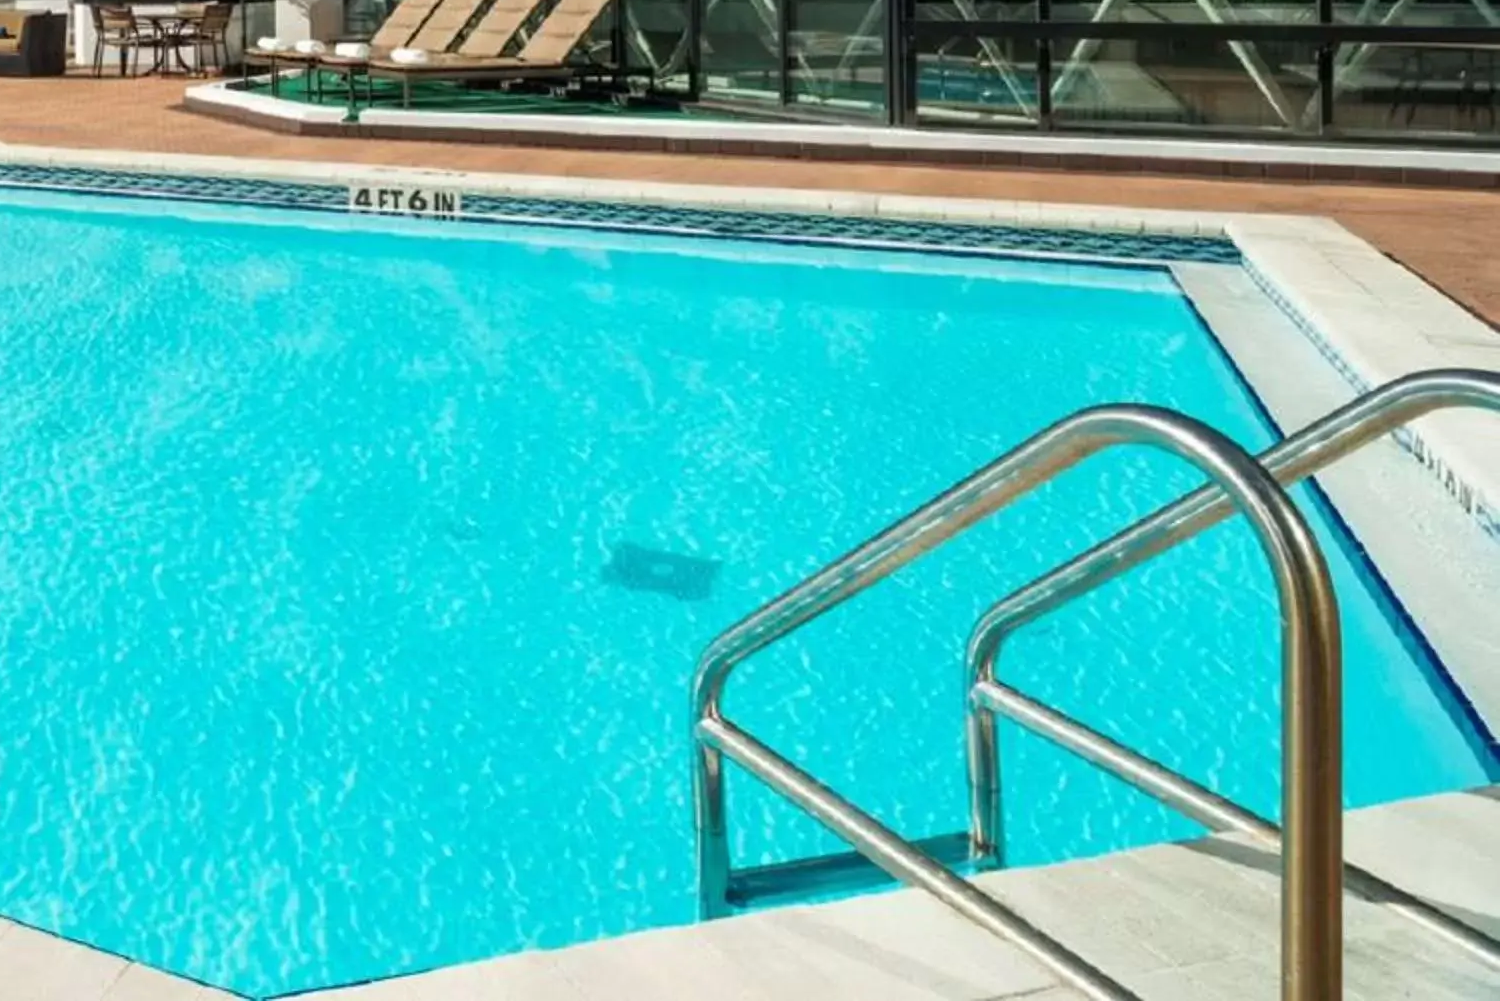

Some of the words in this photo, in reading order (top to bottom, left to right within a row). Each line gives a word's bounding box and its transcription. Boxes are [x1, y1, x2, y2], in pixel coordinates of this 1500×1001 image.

[354, 188, 373, 207] 4
[378, 189, 404, 210] FT
[408, 189, 428, 211] 6
[434, 192, 455, 212] IN
